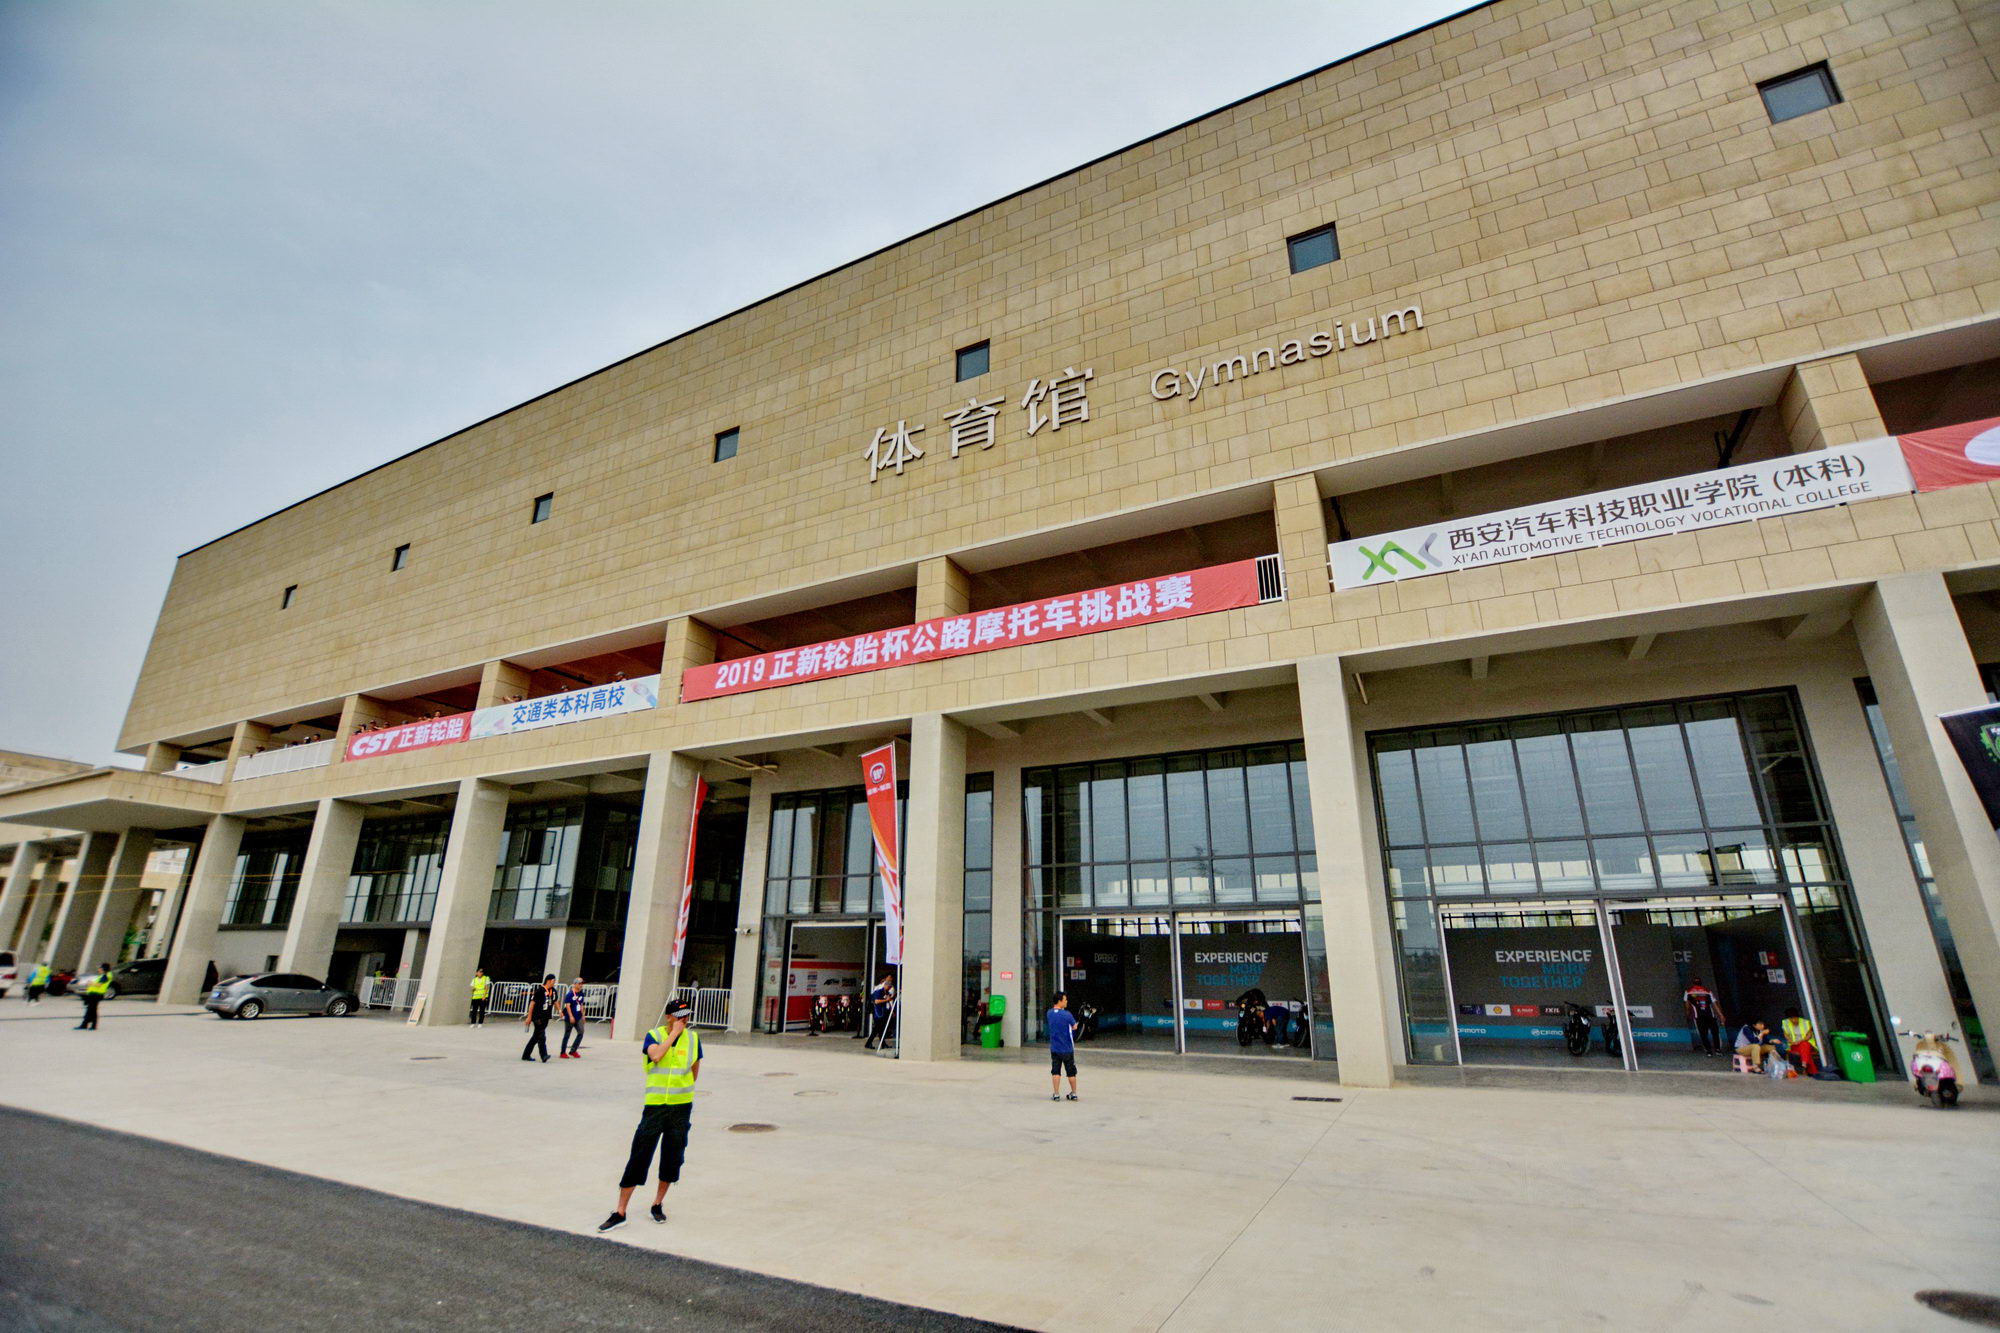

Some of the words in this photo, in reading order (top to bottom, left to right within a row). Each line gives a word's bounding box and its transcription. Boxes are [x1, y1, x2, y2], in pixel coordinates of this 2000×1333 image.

[1150, 304, 1425, 401] Gymnasium
[864, 366, 1094, 483] 体育馆
[1493, 533, 1584, 558] AUTOMOTIVE
[1587, 514, 1686, 541] TECHNOLOGY
[1690, 498, 1792, 523] VOCATIONAL
[1796, 481, 1872, 505] COLLEGE
[714, 658, 766, 690] 2019
[769, 575, 1194, 682] 正新轮胎杯公路摩托车挑战赛
[511, 685, 626, 726] 交通类本科高校
[351, 729, 400, 756] CST
[397, 718, 464, 749] 正新轮胎
[1194, 951, 1269, 963] EXPERIENCE
[1495, 949, 1592, 963] EXPERIENCE
[1499, 975, 1583, 989] TOGETHER
